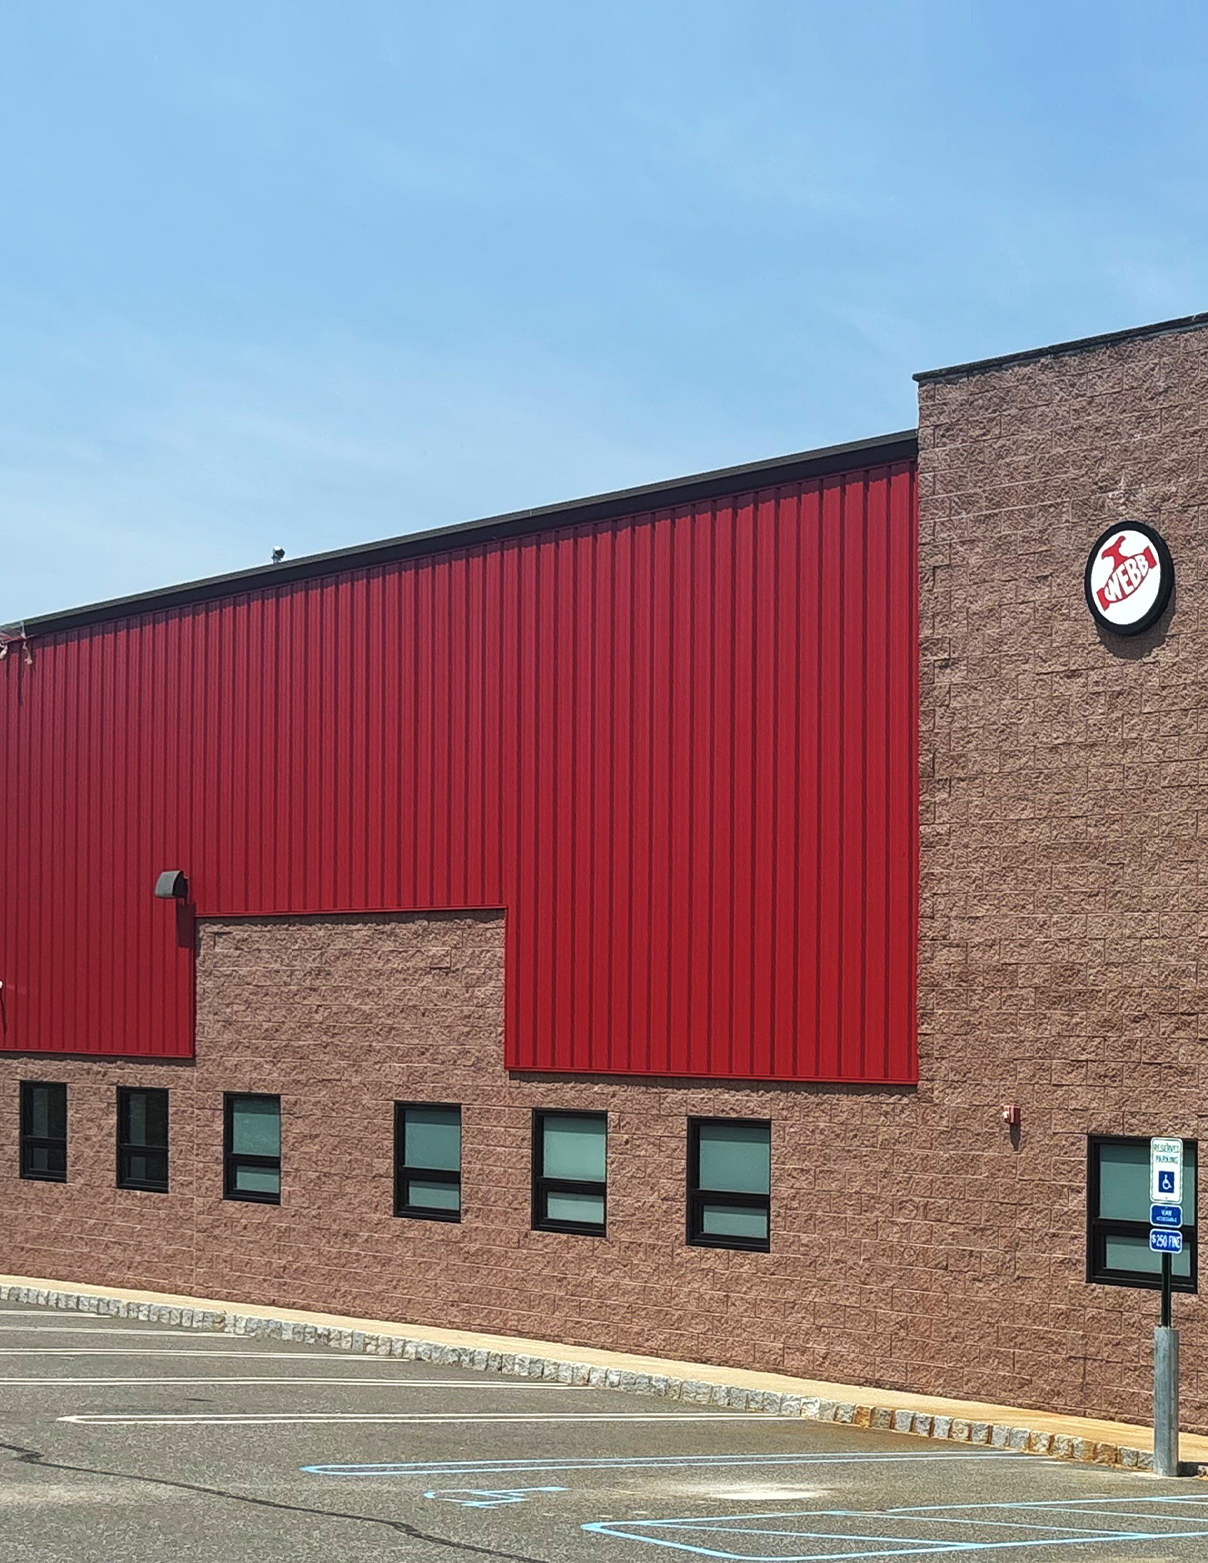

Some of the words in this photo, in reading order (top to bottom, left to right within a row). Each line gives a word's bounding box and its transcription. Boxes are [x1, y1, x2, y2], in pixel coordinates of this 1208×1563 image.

[1104, 554, 1150, 602] WEBB
[1152, 1234, 1168, 1248] $250
[1168, 1235, 1180, 1248] FINE
